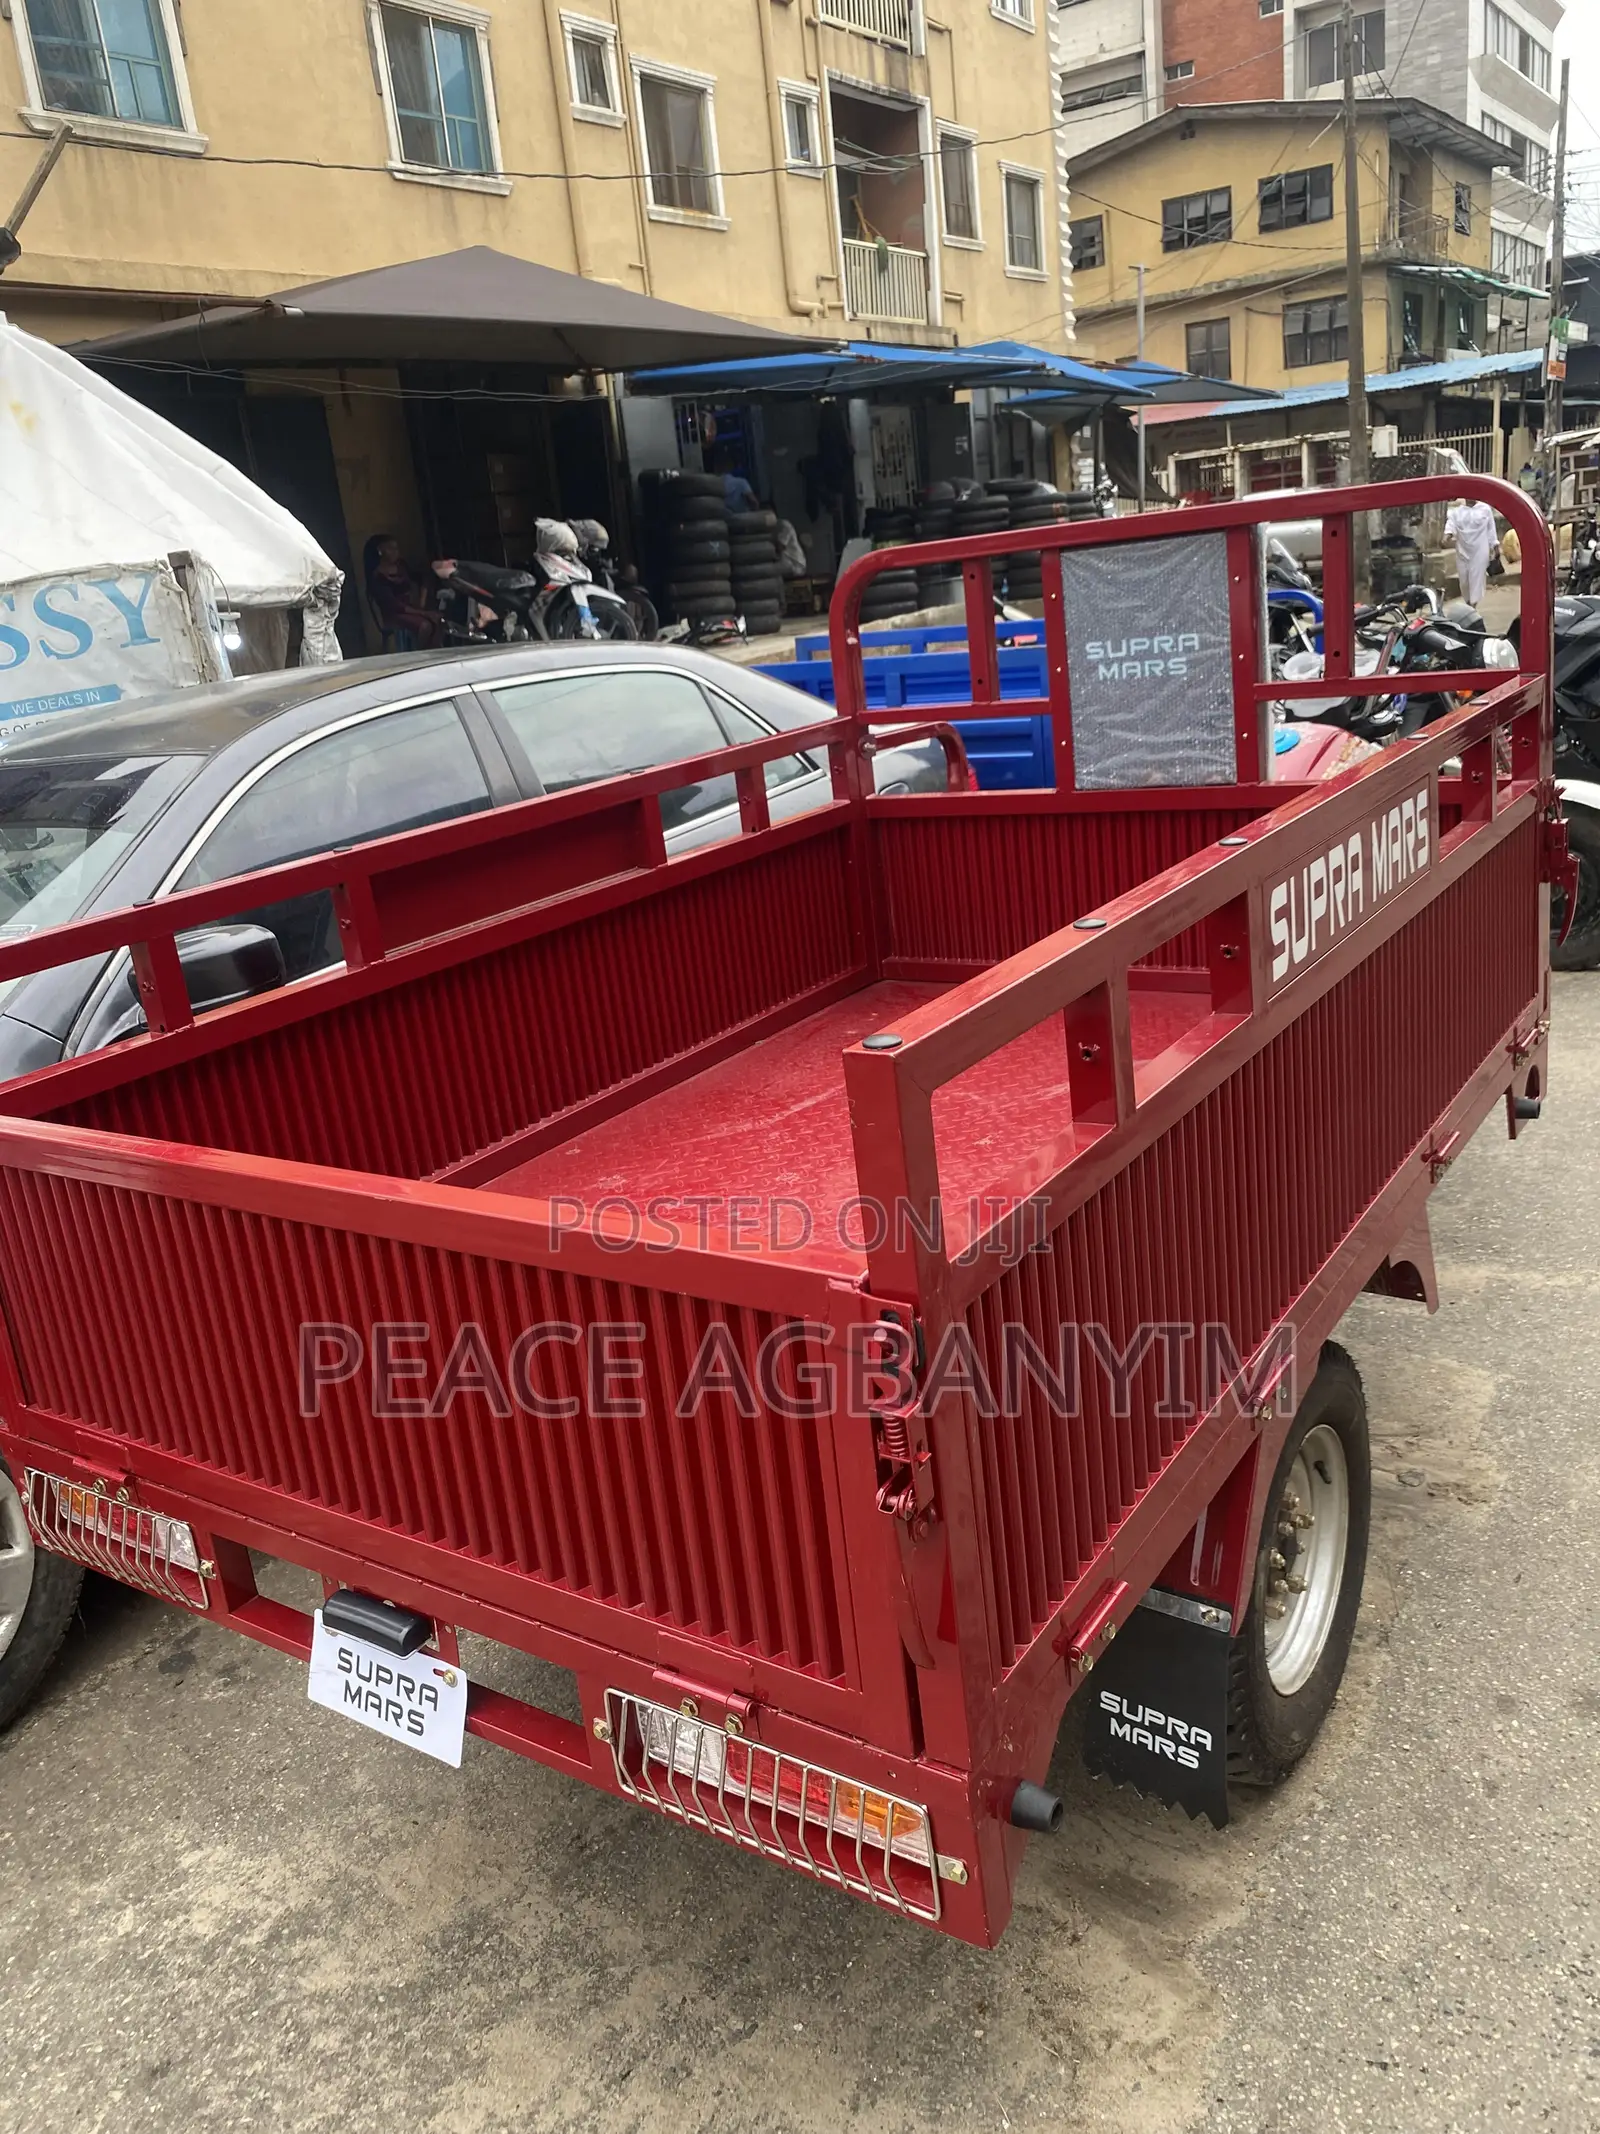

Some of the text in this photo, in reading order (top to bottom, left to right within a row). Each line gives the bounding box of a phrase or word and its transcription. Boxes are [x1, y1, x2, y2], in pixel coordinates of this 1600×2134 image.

[1085, 633, 1200, 660] SUPRA
[1099, 657, 1188, 681] MARS
[11, 690, 101, 716] WE DEALS IN
[1270, 788, 1429, 983] SUPRA MARS
[337, 1647, 439, 1712] SUPRA
[343, 1679, 425, 1737] MARS
[1100, 1690, 1213, 1752] SUPRA
[1110, 1717, 1200, 1769] MARS
